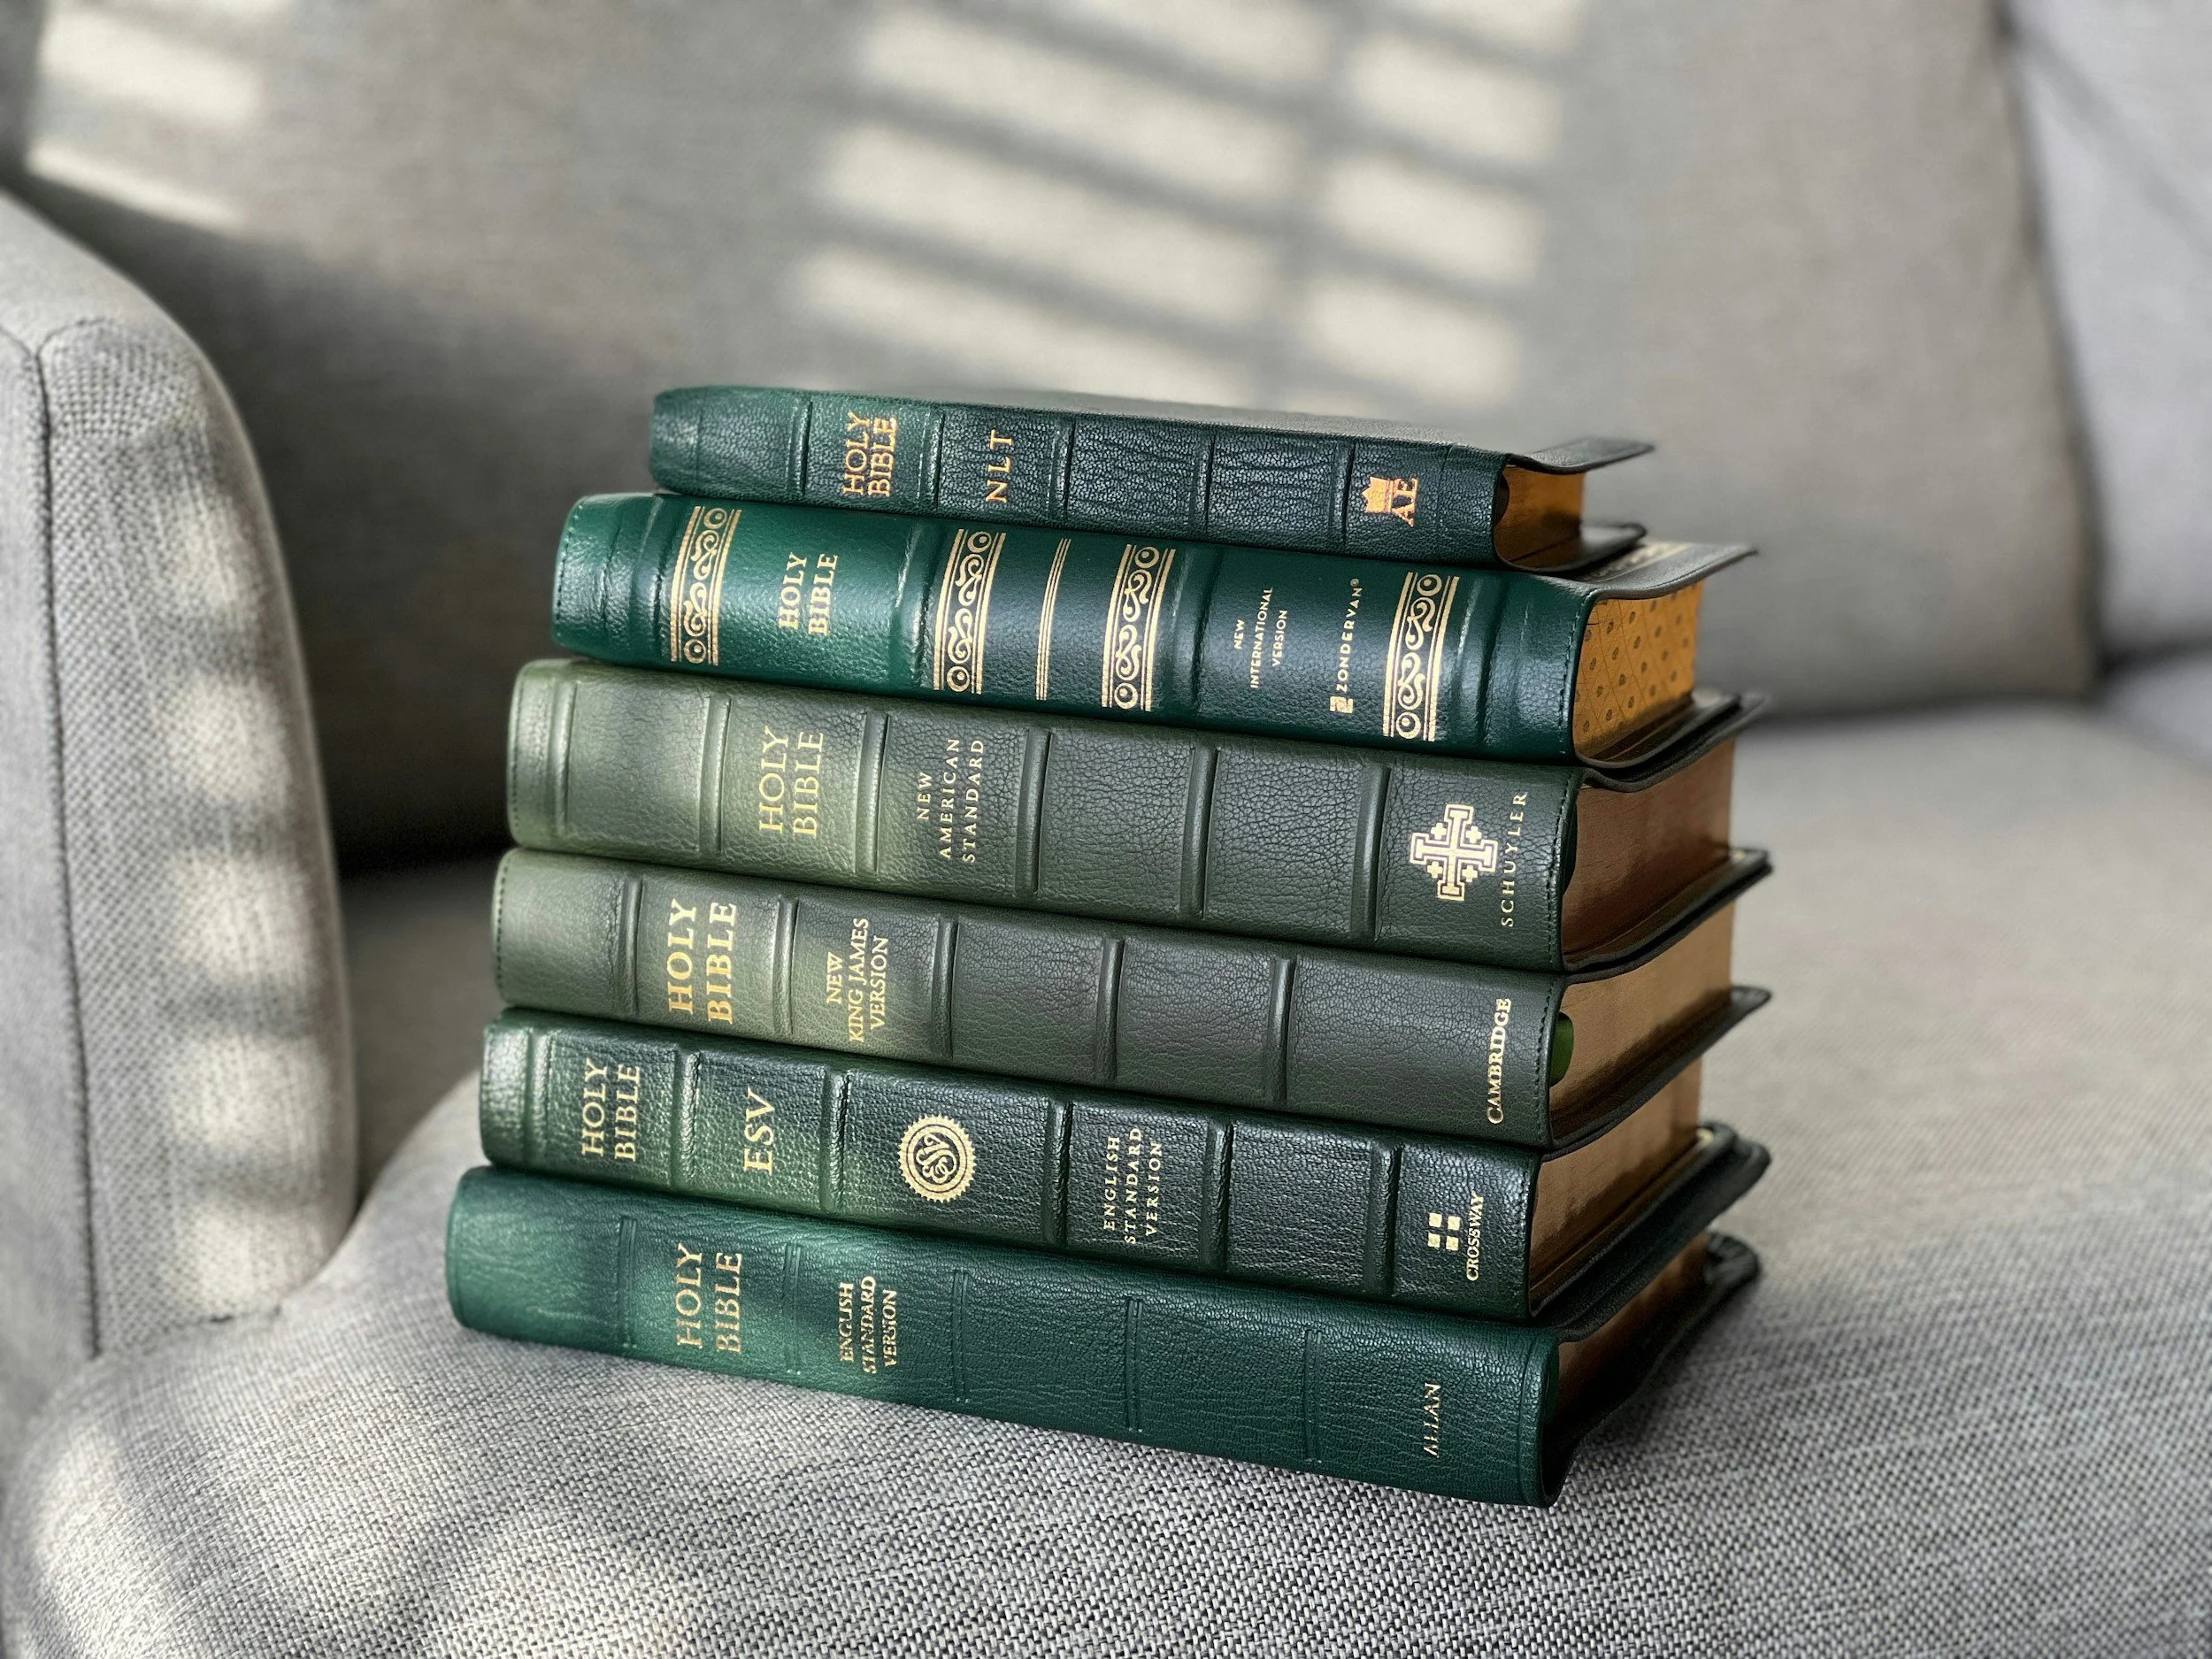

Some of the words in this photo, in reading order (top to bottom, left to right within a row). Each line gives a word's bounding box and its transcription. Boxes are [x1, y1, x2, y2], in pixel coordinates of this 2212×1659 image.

[842, 411, 871, 495] HOLY
[867, 417, 898, 497] BIBLE
[778, 551, 808, 629] HOLY
[808, 553, 839, 636] BIBLE
[1233, 619, 1245, 649] NEW
[1250, 587, 1274, 688] INTERNATIONAL
[1271, 609, 1288, 668] VERSION
[759, 725, 790, 833] HOLY
[793, 731, 825, 838] BIBLE
[917, 772, 933, 821] NEW
[939, 738, 961, 859] AMERICAN
[962, 739, 984, 863] STANDARD
[1501, 792, 1529, 927] SCHUYLER
[666, 897, 697, 1014] HOLY
[706, 902, 738, 1025] BIBLE
[826, 951, 844, 1004] NEW
[849, 917, 869, 986] JAMES
[869, 935, 889, 1030] VERSION
[848, 987, 865, 1043] KING
[1486, 998, 1512, 1125] CAMBRIDGE
[581, 1057, 608, 1157] HOLY
[615, 1064, 641, 1162] BIBLE
[743, 1087, 775, 1176] ESV
[1102, 1136, 1121, 1231] ENGLISH
[1124, 1127, 1142, 1245] STANDARD
[1145, 1141, 1163, 1238] VERSION
[1466, 1191, 1485, 1282] CROSSWAY
[676, 1242, 703, 1349] HOLY
[715, 1251, 742, 1356] BIBLE
[839, 1282, 855, 1363] ENGLISH
[861, 1276, 877, 1375] STANDARD
[883, 1289, 898, 1368] VERSION
[1423, 1382, 1442, 1458] ALLAN
